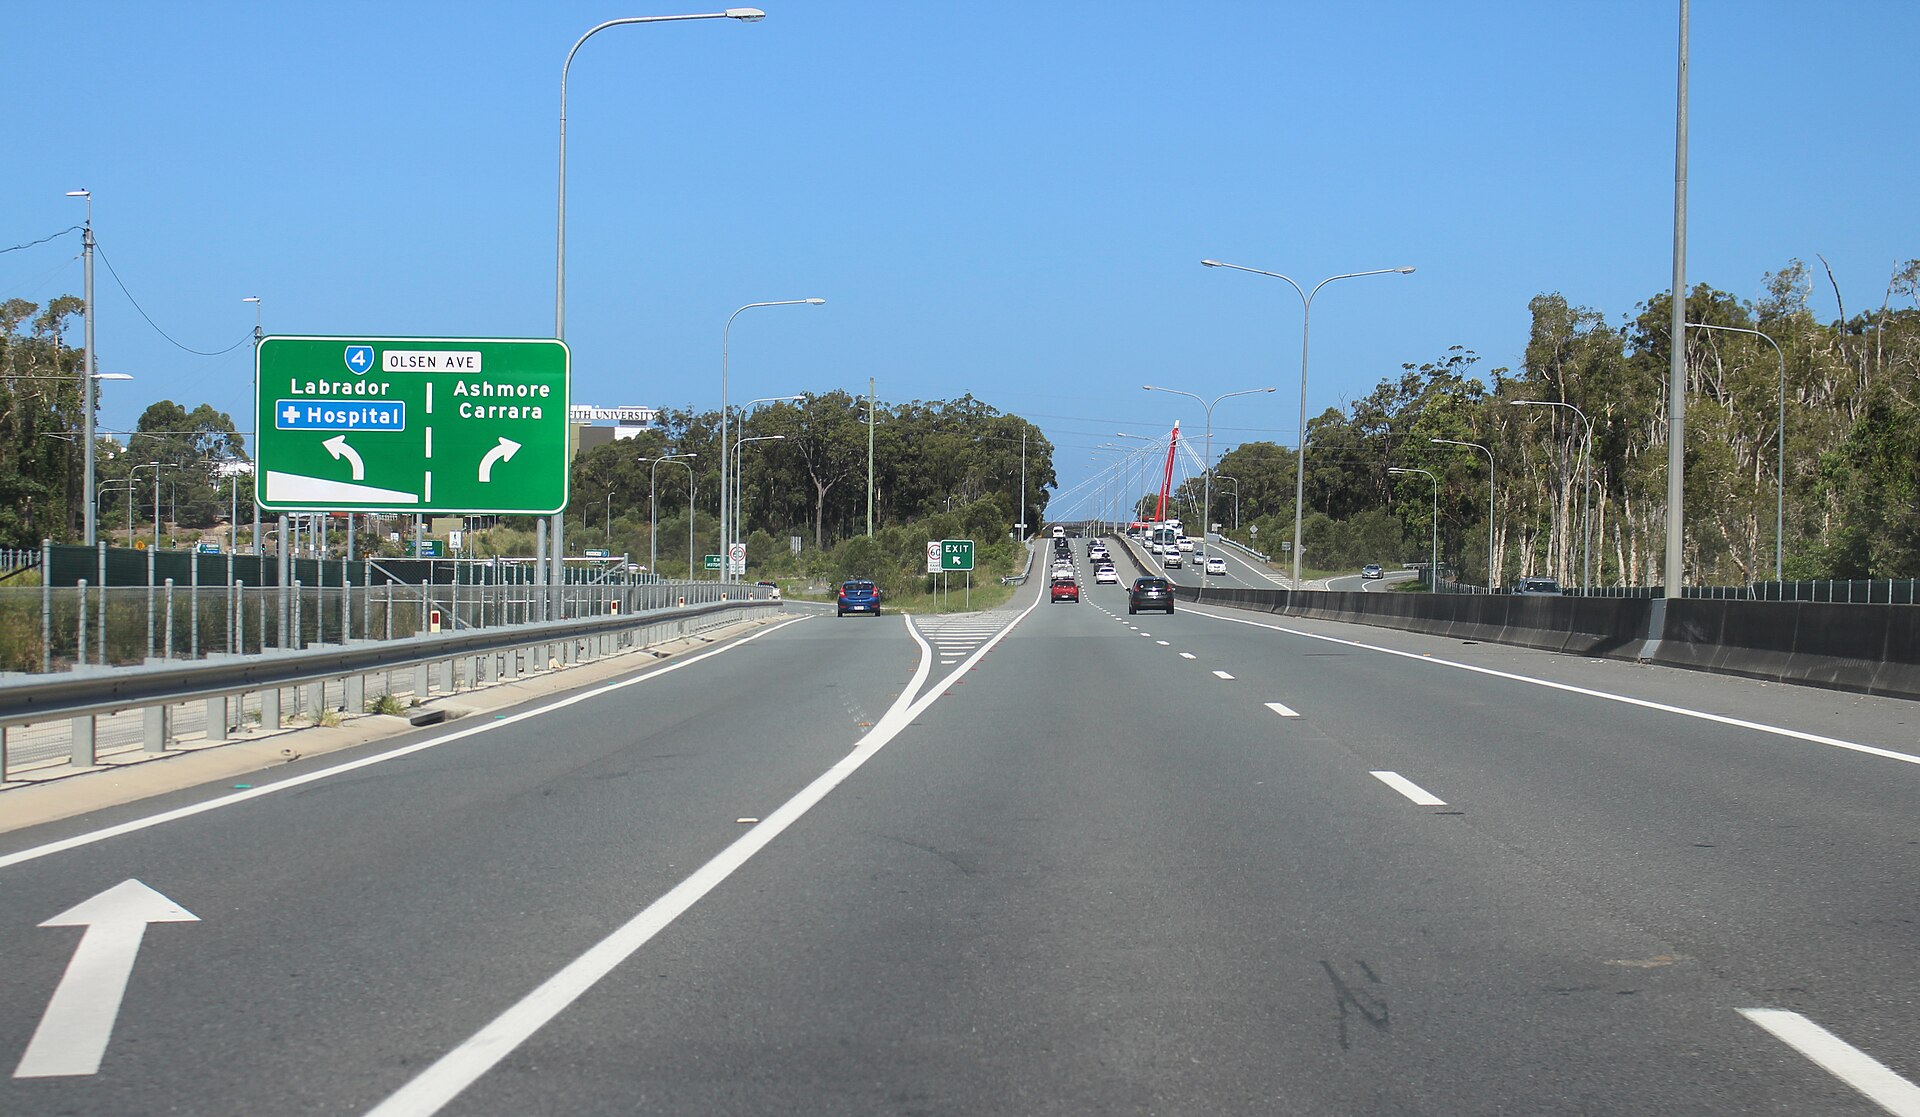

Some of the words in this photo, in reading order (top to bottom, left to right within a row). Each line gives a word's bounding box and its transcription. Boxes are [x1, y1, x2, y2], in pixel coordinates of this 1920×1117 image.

[351, 350, 365, 366] 4
[390, 355, 436, 369] OLSEN
[445, 356, 475, 369] AVE
[291, 378, 390, 396] Labrador
[453, 380, 550, 398] Ashmore
[307, 406, 399, 428] Hospital
[459, 402, 543, 420] Carrara
[596, 411, 656, 420] UNIVERSITY
[945, 544, 968, 553] EXIT
